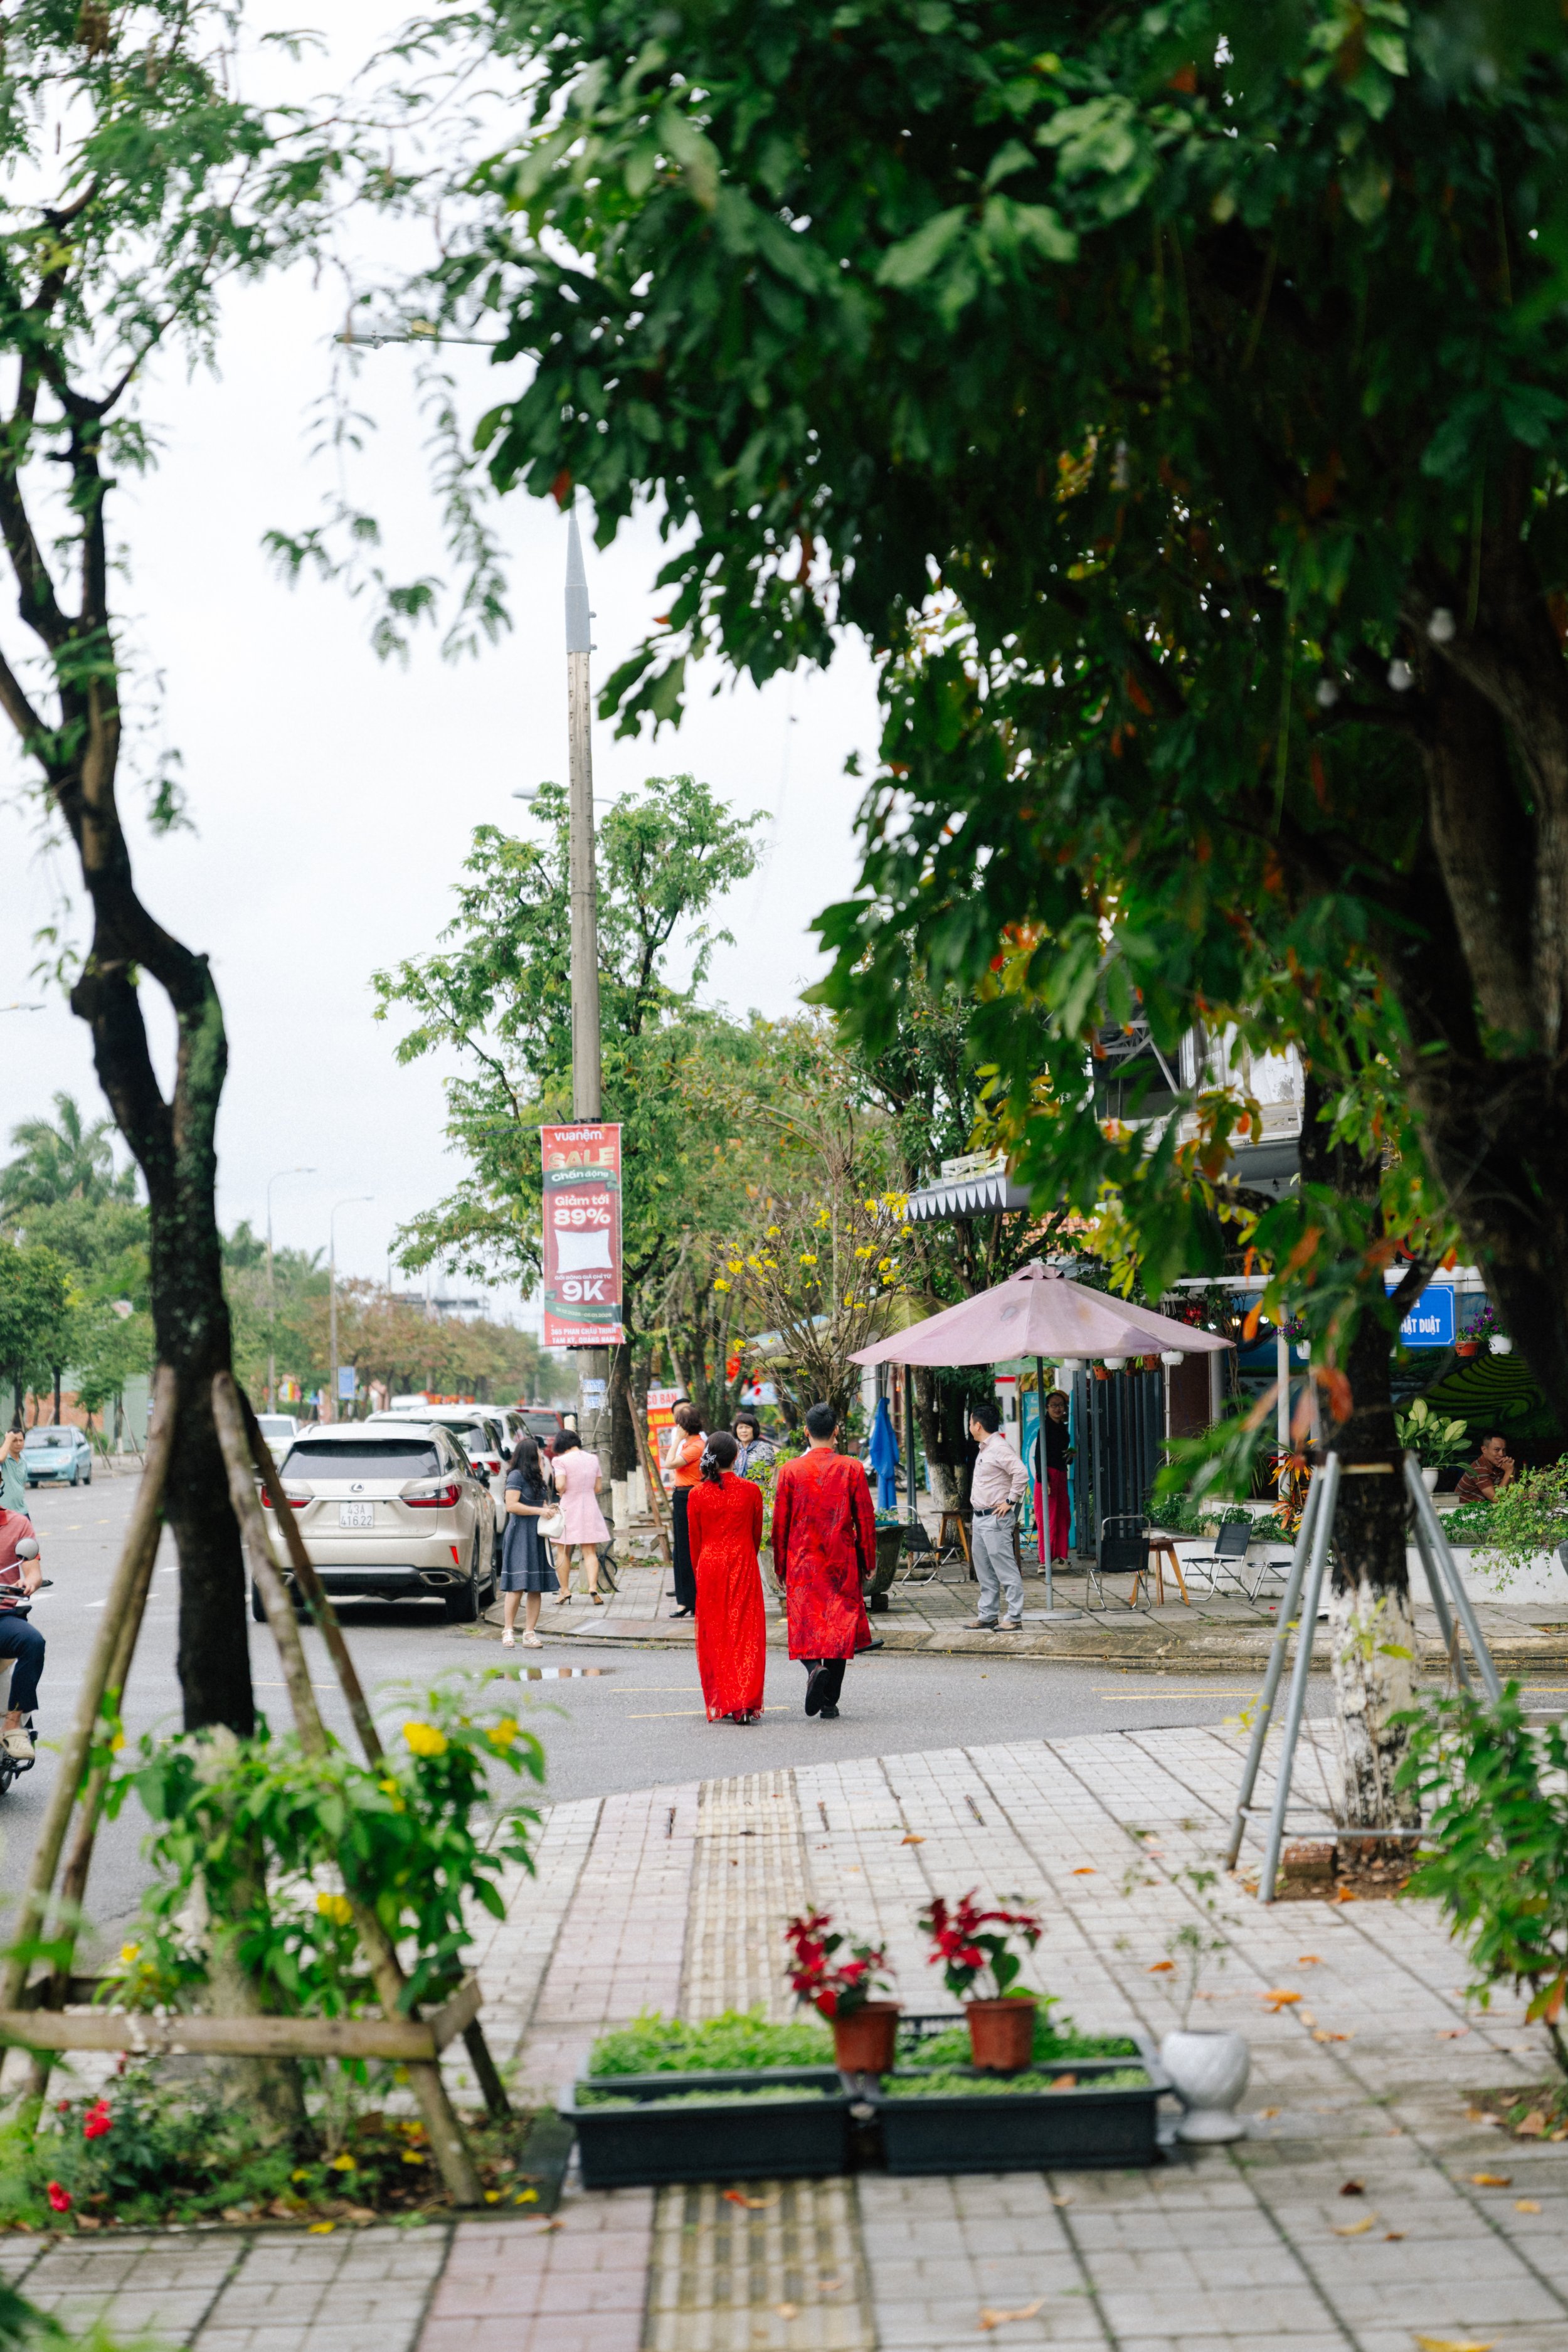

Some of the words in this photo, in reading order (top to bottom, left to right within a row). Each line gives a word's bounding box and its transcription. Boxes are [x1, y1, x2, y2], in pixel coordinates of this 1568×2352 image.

[548, 1146, 615, 1170] SALE
[555, 1194, 590, 1206] Giảm
[591, 1194, 610, 1205] tới
[554, 1208, 611, 1225] 89%
[562, 1279, 605, 1302] 9K
[1419, 1315, 1441, 1335] DUẬT
[347, 1505, 365, 1515] 43A
[341, 1515, 372, 1526] 416.22
